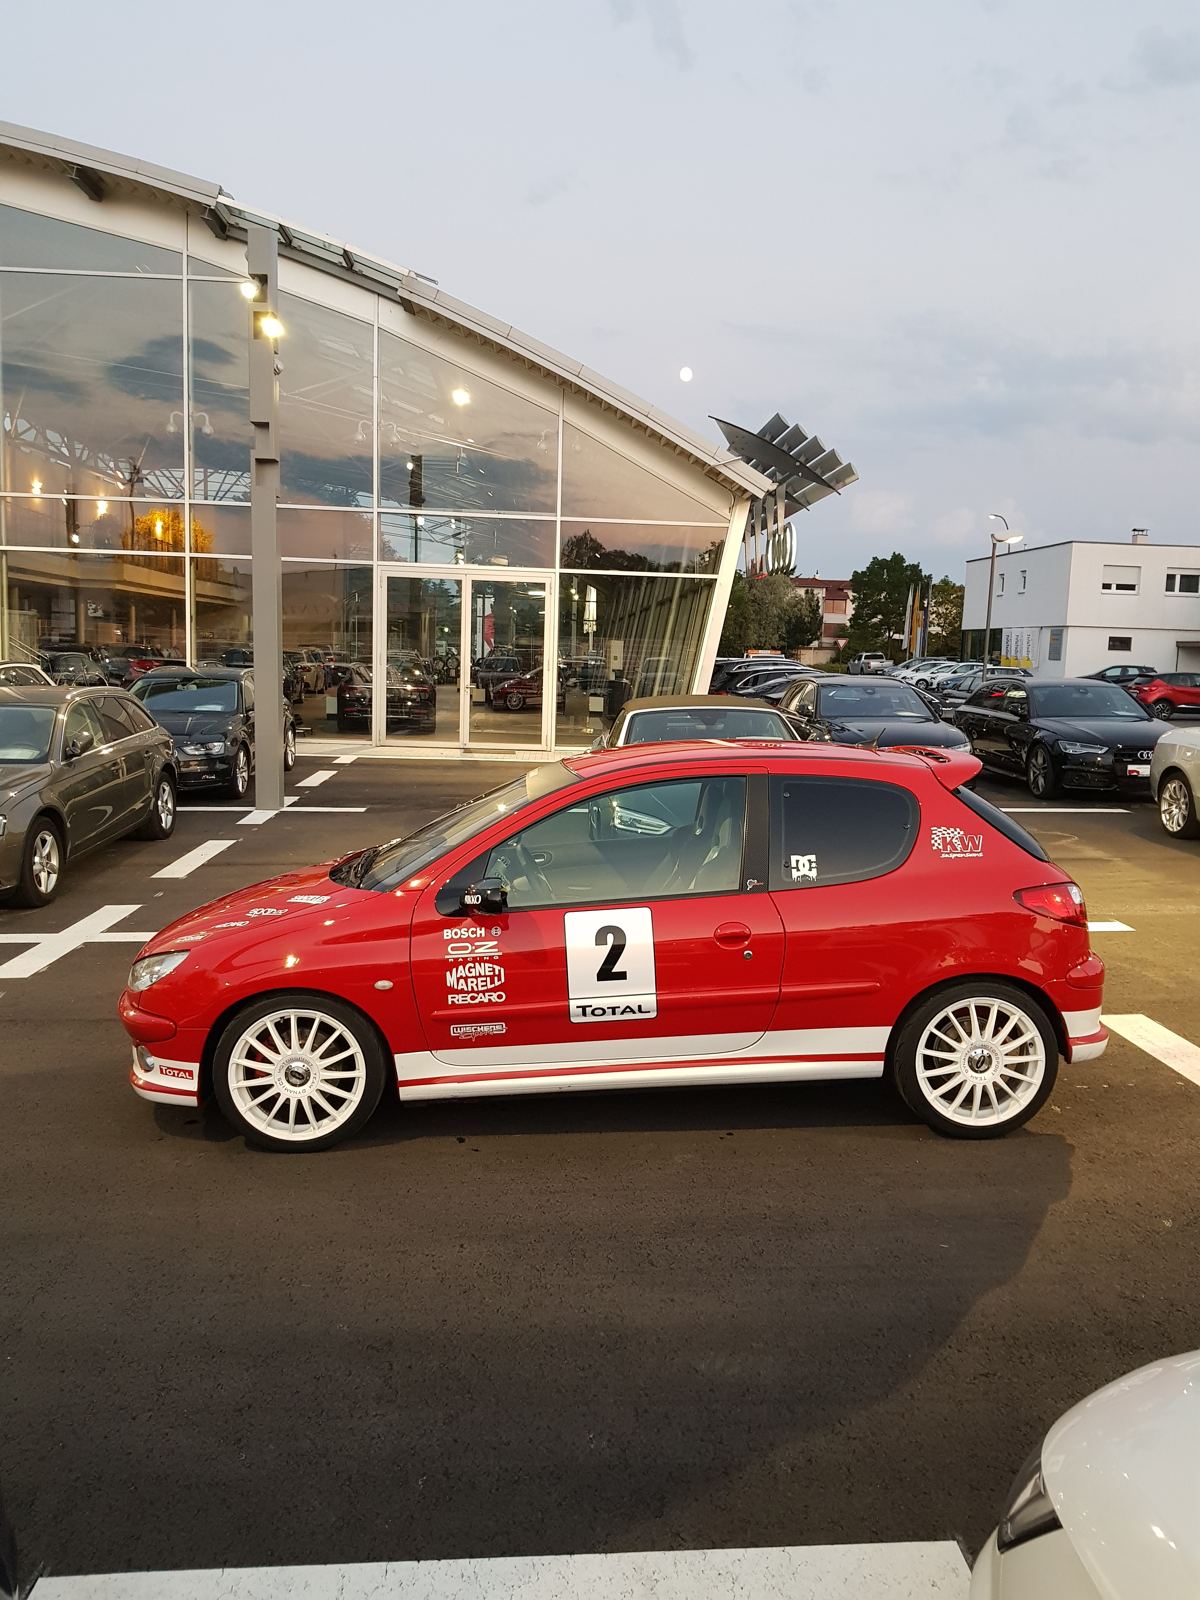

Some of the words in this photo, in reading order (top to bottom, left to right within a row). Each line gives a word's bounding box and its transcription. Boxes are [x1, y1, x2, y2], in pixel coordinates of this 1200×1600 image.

[940, 834, 983, 853] KW
[790, 854, 818, 881] DC
[443, 927, 485, 940] BOSCH
[448, 955, 500, 963] RACING
[594, 924, 628, 982] 2
[445, 962, 505, 983] MAGNETI
[445, 972, 505, 992] MARELLI
[447, 991, 506, 1005] RECARO
[575, 1004, 651, 1018] TOTAL
[160, 1066, 193, 1079] TOTAL
